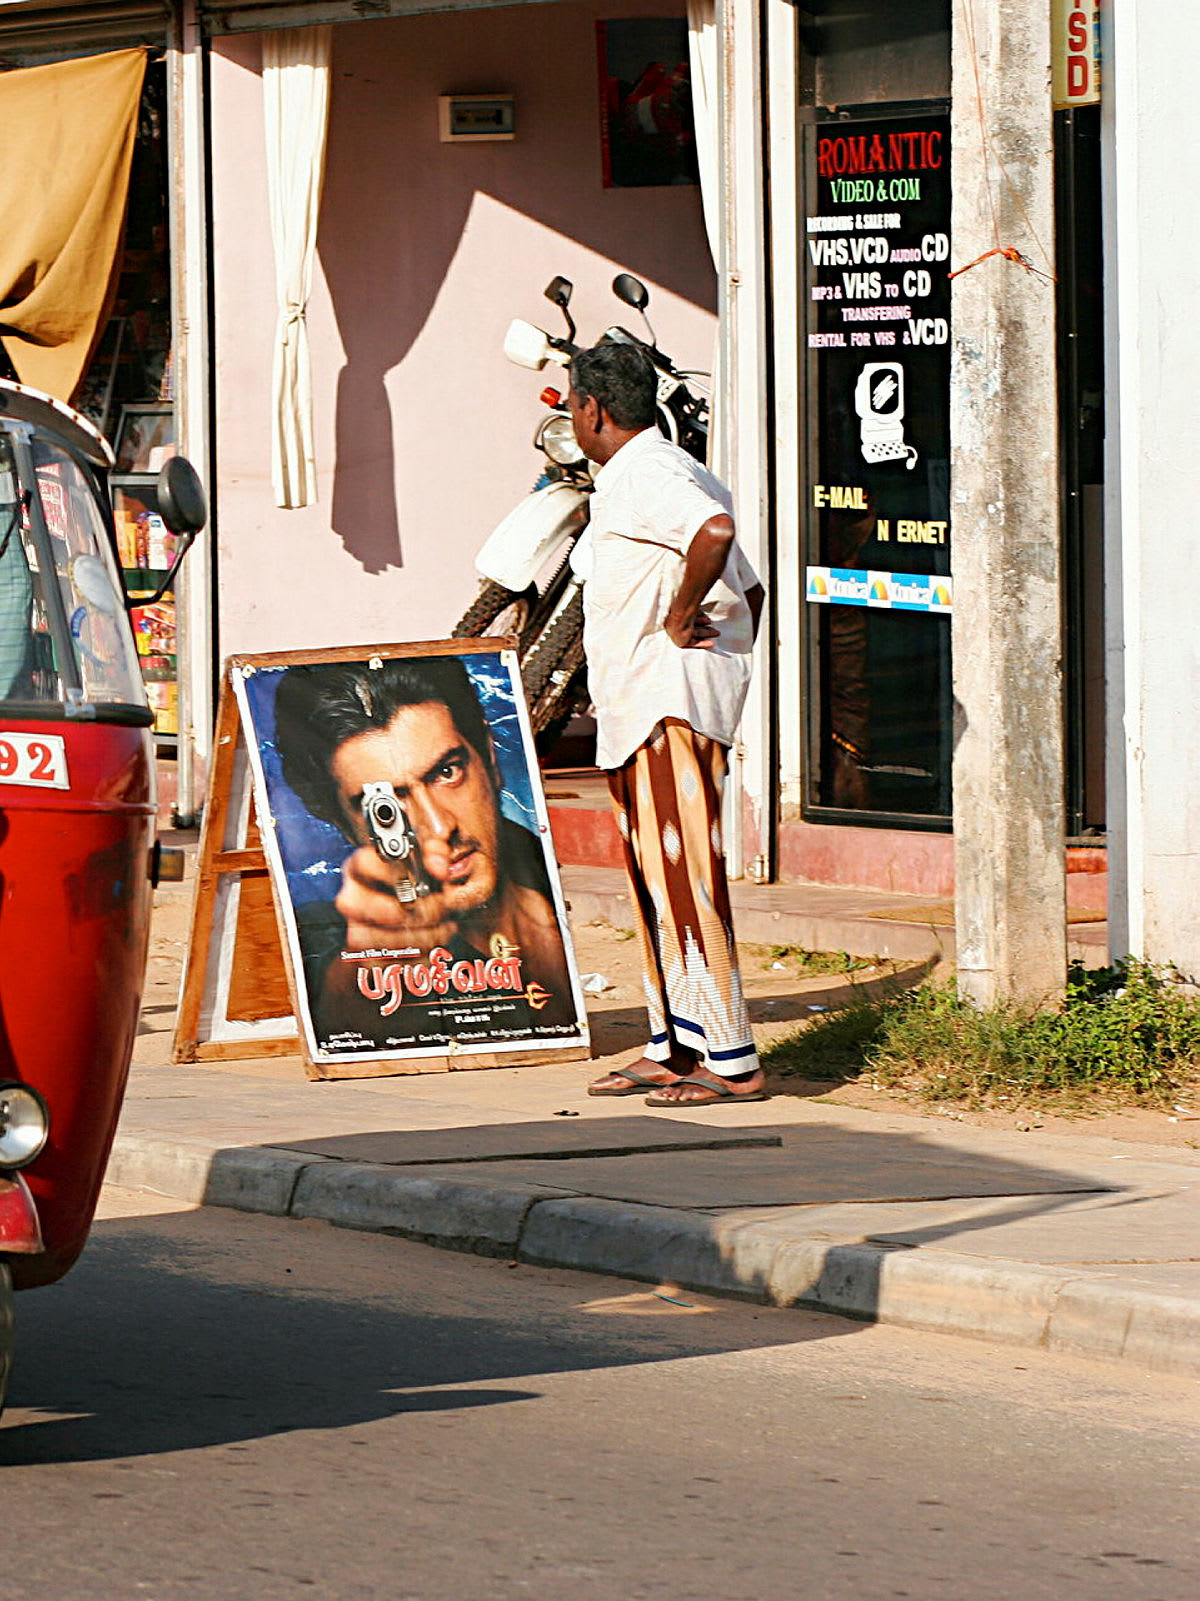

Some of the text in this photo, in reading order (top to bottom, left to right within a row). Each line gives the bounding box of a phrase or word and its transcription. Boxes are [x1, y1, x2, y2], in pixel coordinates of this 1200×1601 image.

[1067, 0, 1089, 97] SD
[817, 131, 942, 178] ROMANTIC
[830, 178, 921, 203] VIDEO & COM
[889, 248, 921, 263] AUDIO
[921, 233, 949, 262] CD
[811, 269, 932, 301] MP3 & VHS TO CD
[808, 318, 949, 348] RENTAL FOR VHS & VCD
[814, 485, 868, 510] E-MAIL
